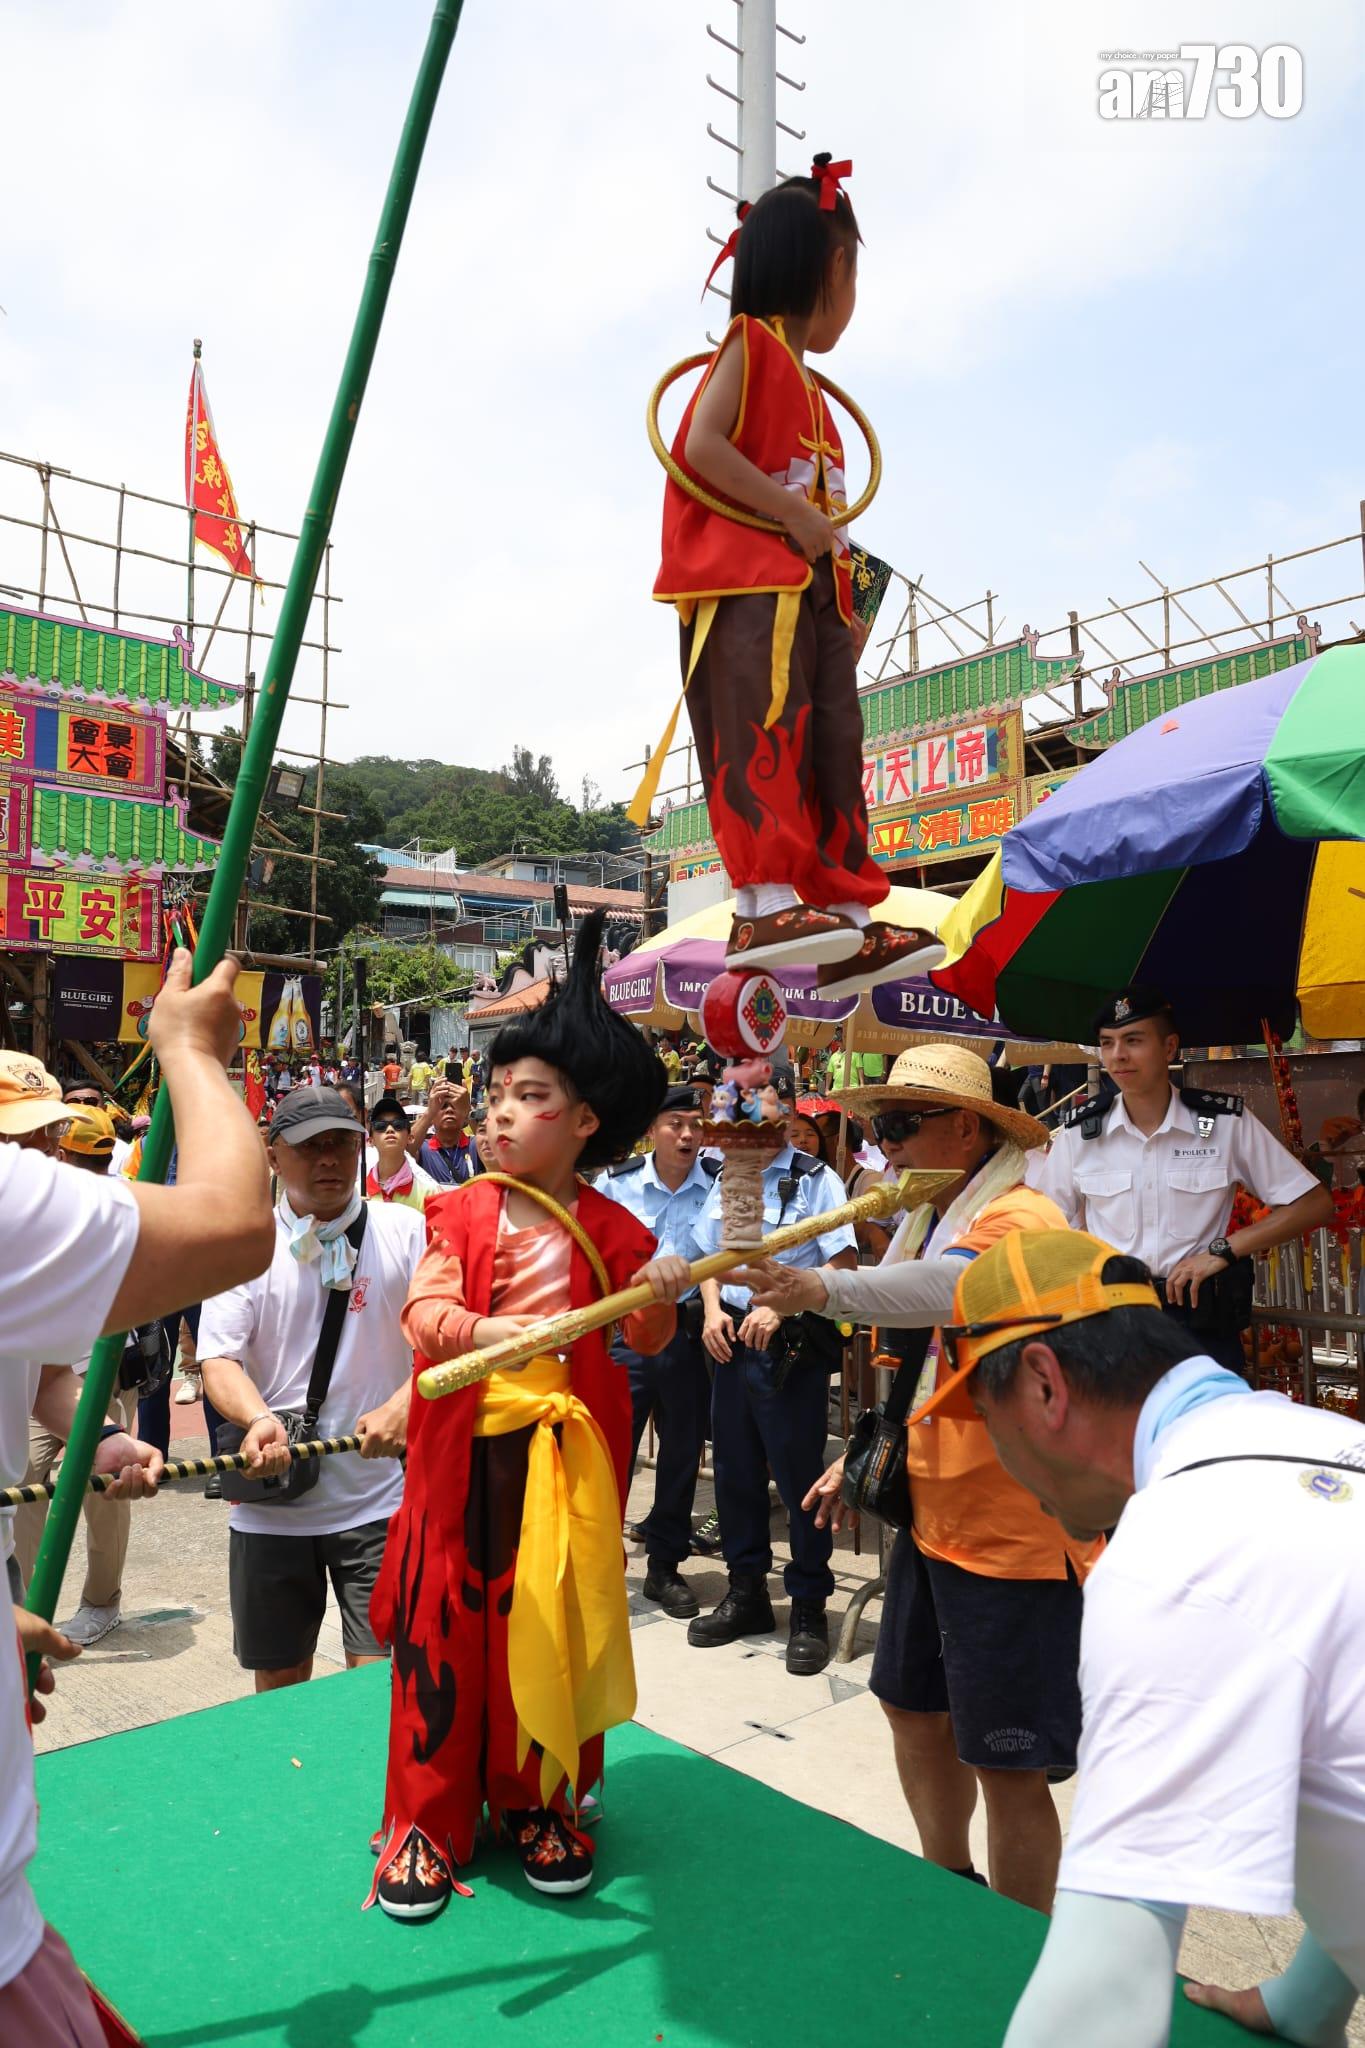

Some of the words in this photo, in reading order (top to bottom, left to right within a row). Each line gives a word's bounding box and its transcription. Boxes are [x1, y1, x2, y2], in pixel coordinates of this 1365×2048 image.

[26, 881, 116, 941] 平安
[900, 991, 967, 1019] BLUE
[1182, 1148, 1208, 1156] POLICE
